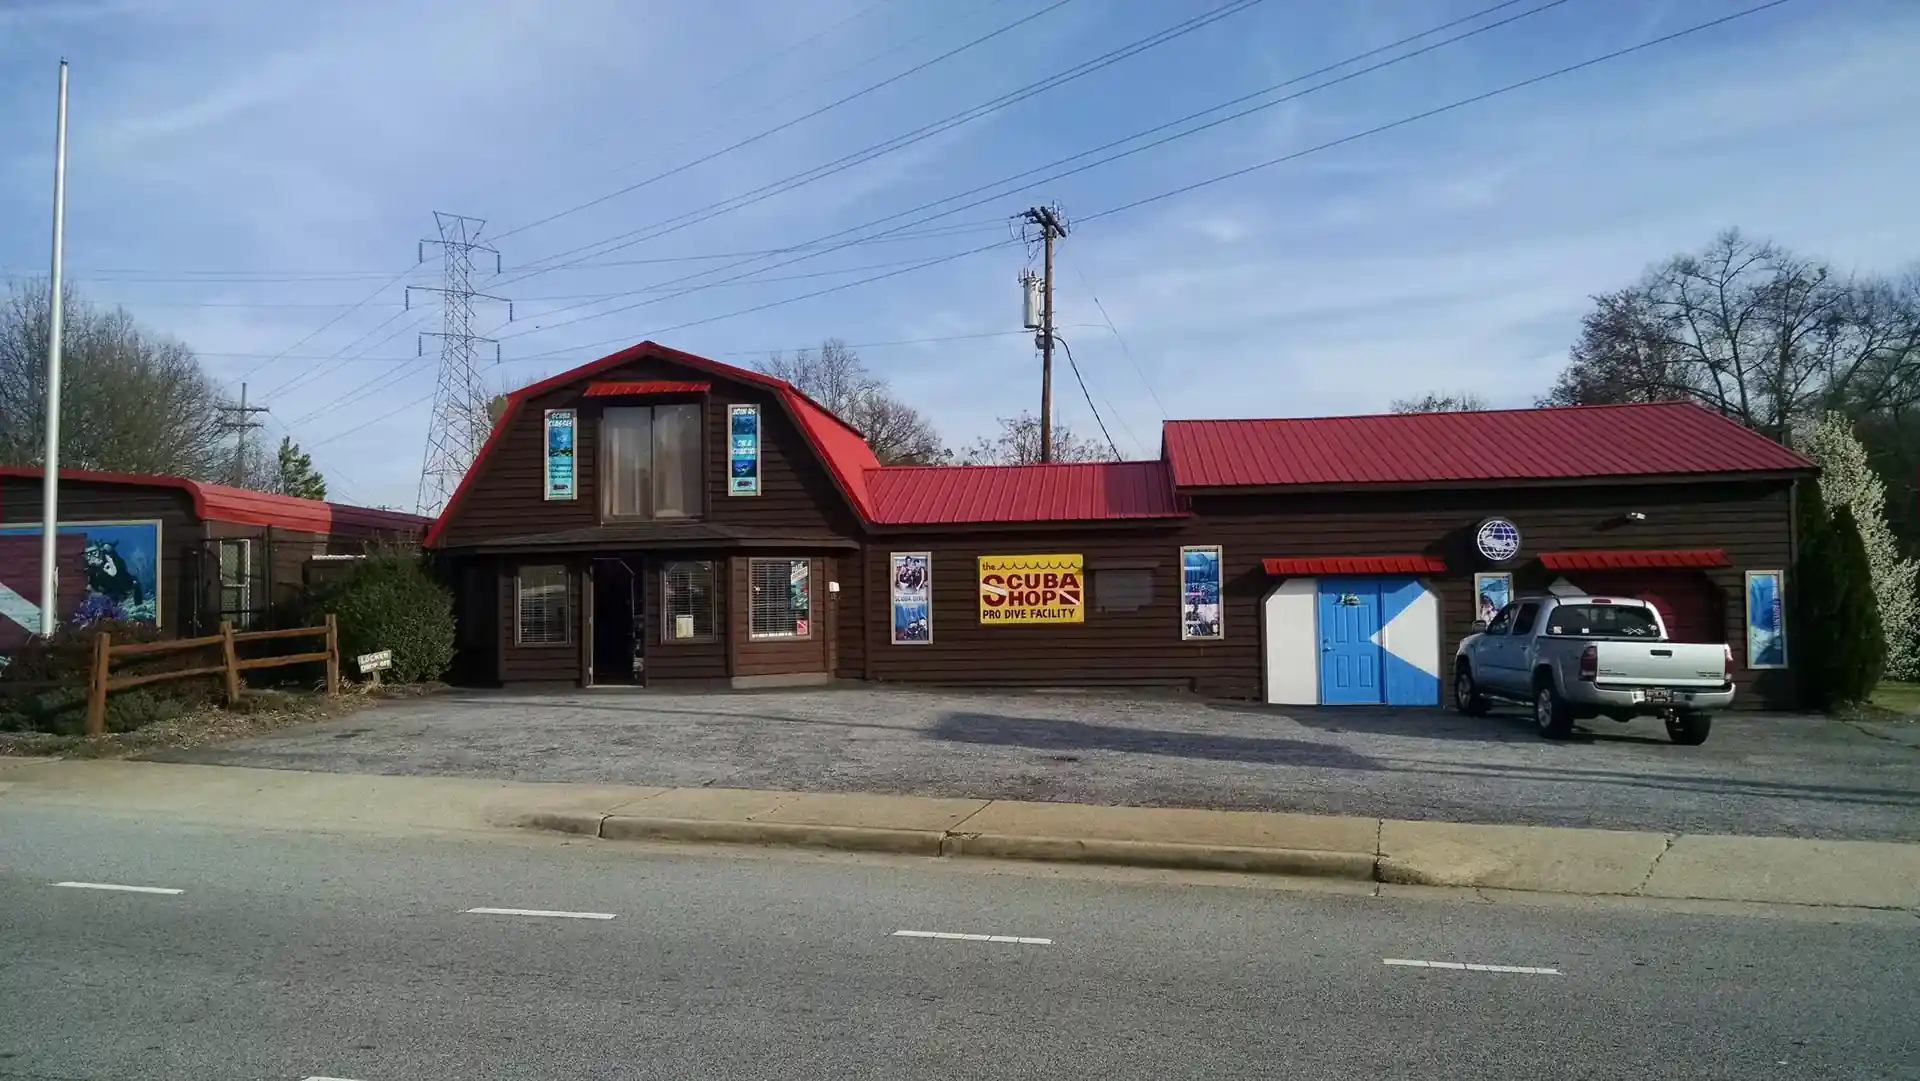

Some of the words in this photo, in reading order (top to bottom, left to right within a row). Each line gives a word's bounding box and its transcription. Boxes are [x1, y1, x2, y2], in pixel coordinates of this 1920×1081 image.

[982, 561, 996, 571] the
[983, 573, 1080, 593] SCUBA
[983, 588, 1057, 607] SHOP
[983, 609, 1001, 619] PRO
[1005, 609, 1026, 619] DIVE
[1030, 608, 1075, 618] FACILITY
